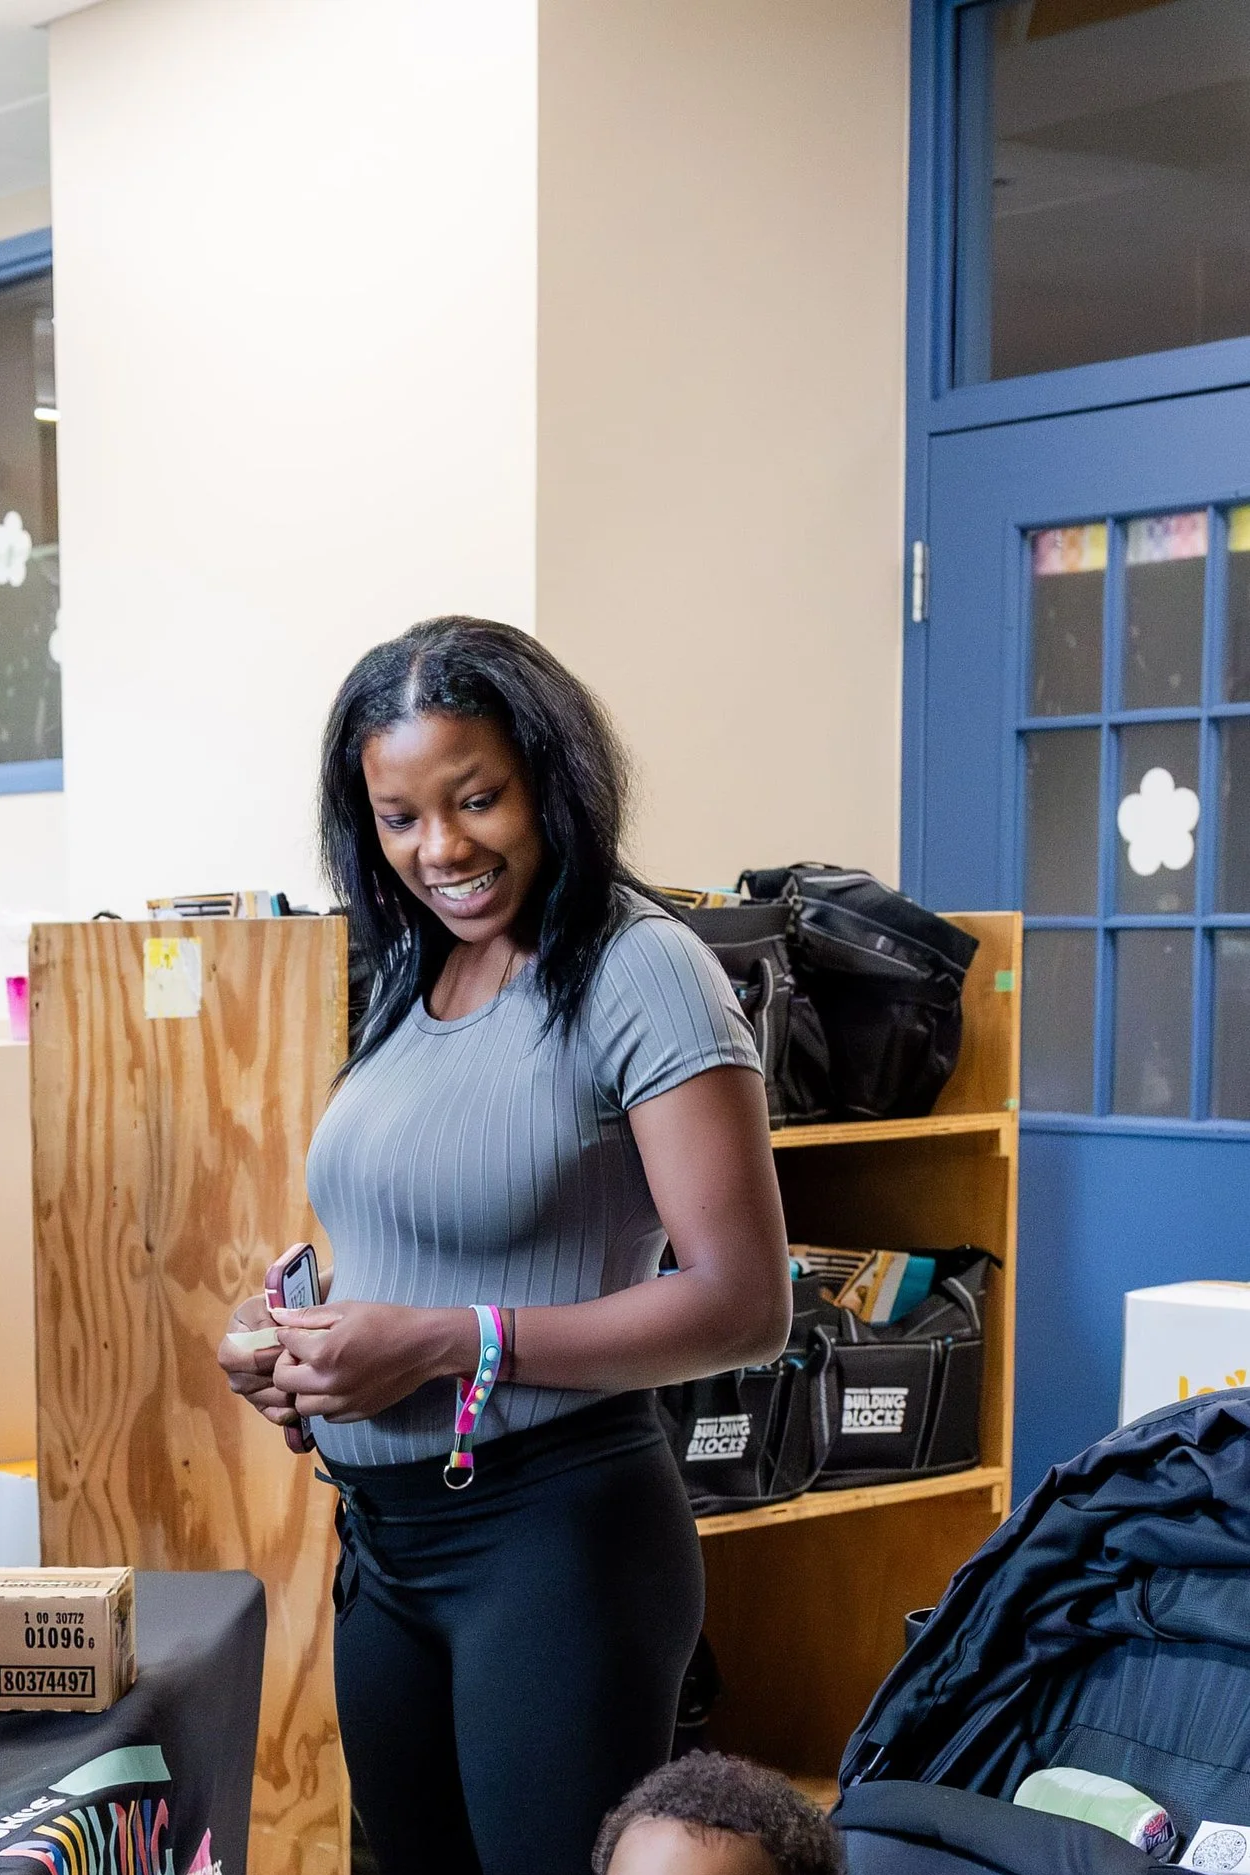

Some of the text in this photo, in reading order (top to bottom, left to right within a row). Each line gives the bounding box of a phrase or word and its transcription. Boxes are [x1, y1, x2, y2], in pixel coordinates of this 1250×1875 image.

[843, 1394, 907, 1410] BUILDING
[842, 1409, 905, 1427] BLOCKS
[693, 1421, 751, 1439] BUILDING
[687, 1436, 748, 1455] BLOCKS
[24, 1611, 84, 1624] 1 00 30772
[25, 1627, 84, 1649] 01096
[4, 1670, 89, 1692] 80374497
